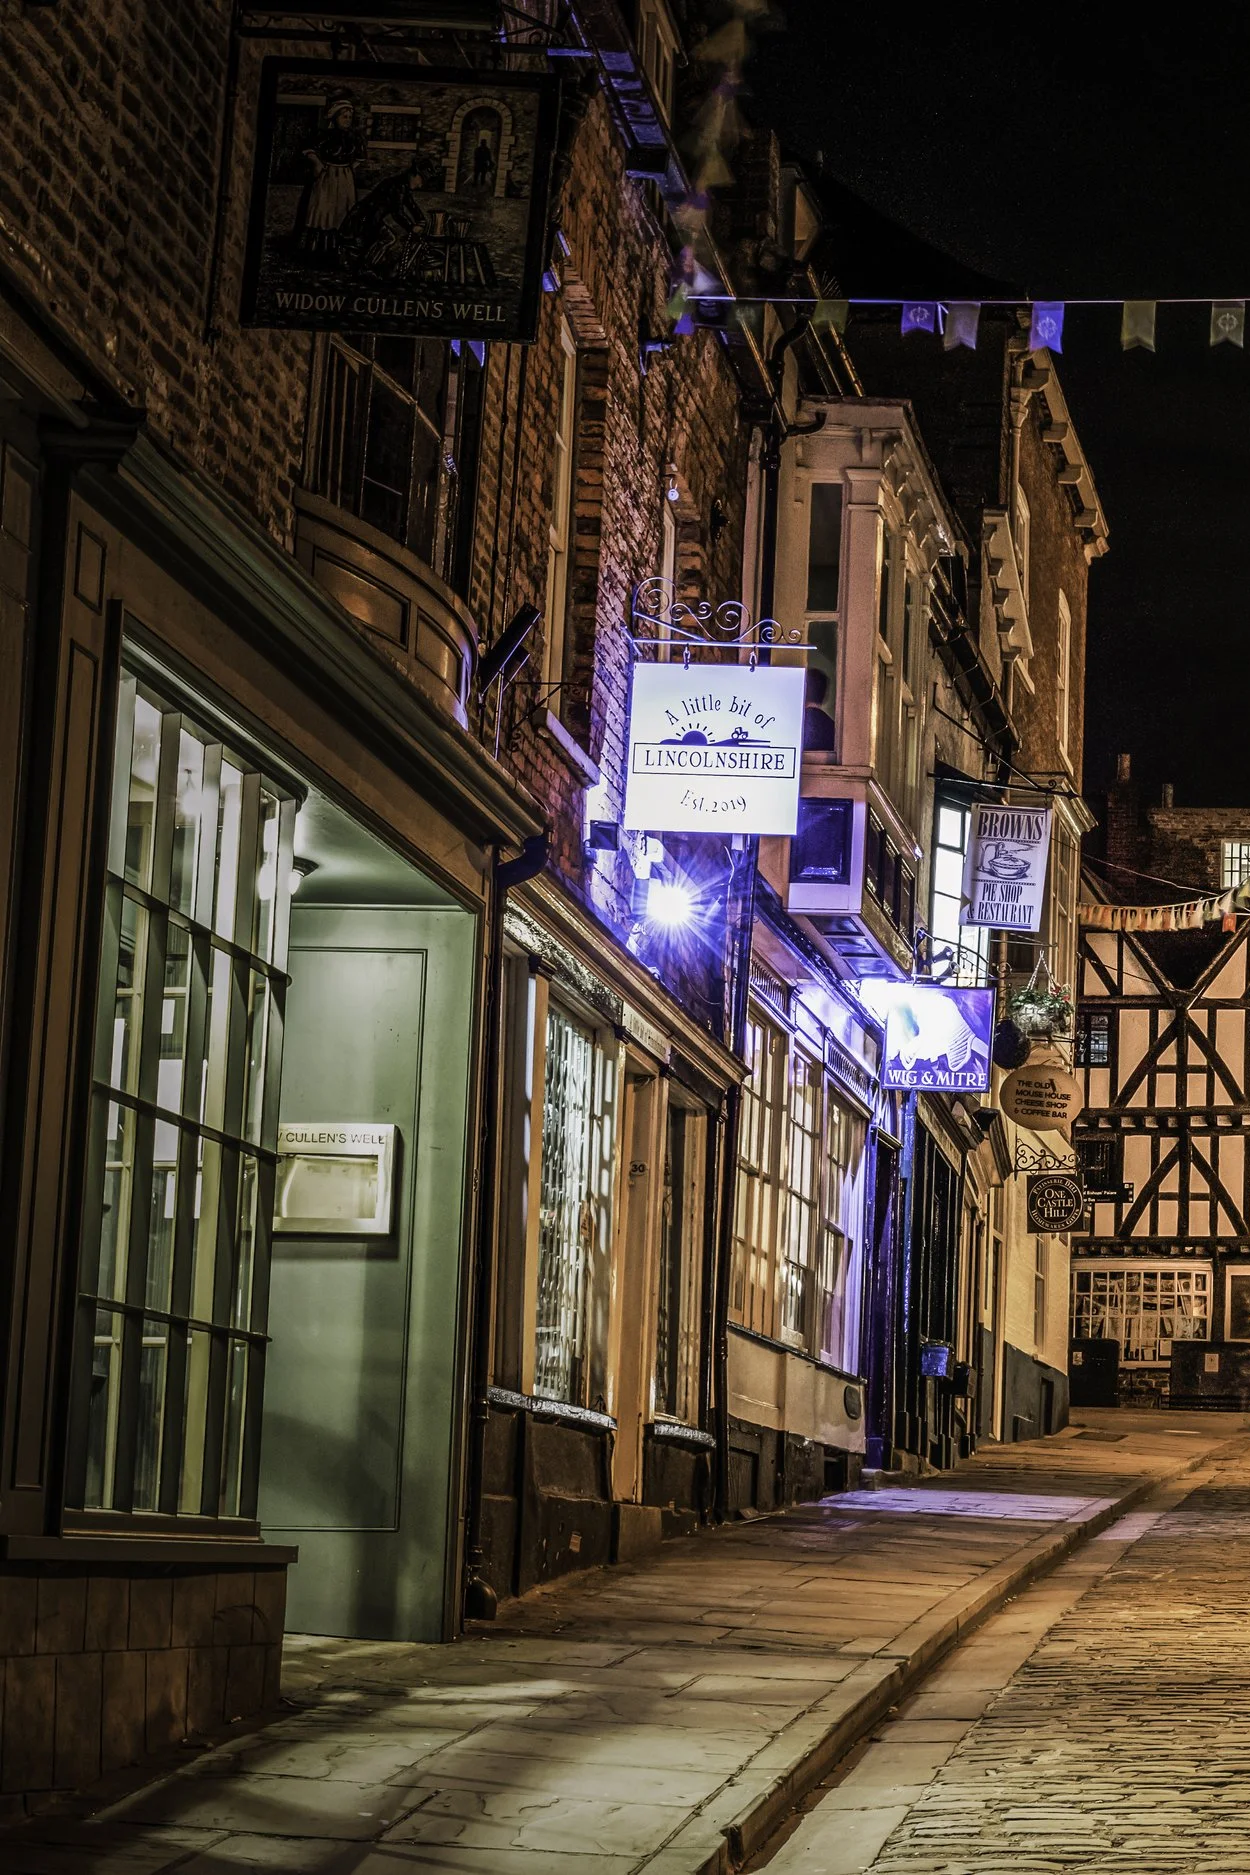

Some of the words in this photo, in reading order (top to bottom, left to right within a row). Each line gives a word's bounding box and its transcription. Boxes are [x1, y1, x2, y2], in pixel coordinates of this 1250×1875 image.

[276, 291, 346, 312] WIDOW
[353, 297, 444, 318] CULLEN'S
[452, 303, 506, 322] WELL
[665, 709, 680, 726] A
[681, 694, 721, 716] little
[728, 695, 752, 717] bit
[754, 713, 776, 729] of
[645, 750, 785, 770] LINCOLNSHIRE
[977, 812, 1044, 840] BROWNS
[981, 883, 999, 902] PIE
[999, 885, 1023, 903] SHOP
[967, 903, 974, 919] &
[977, 901, 1034, 924] RESTAURANT
[888, 1069, 917, 1085] WIG
[921, 1071, 934, 1085] &
[936, 1071, 987, 1087] MITRE
[1015, 1089, 1044, 1098] MOUSE
[1045, 1092, 1071, 1100] HOUSE
[1015, 1099, 1044, 1107] CHEESE
[1045, 1101, 1068, 1109] SHOP
[1021, 1108, 1051, 1118] COFFEE
[1052, 1111, 1068, 1119] BAR
[285, 1132, 347, 1143] CULLEN'S
[350, 1133, 385, 1144] WELL
[631, 1164, 646, 1173] 30
[1044, 1188, 1066, 1199] ONE
[1064, 1180, 1078, 1194] DELI
[1037, 1197, 1074, 1208] CASTLE
[1044, 1207, 1067, 1218] HILL
